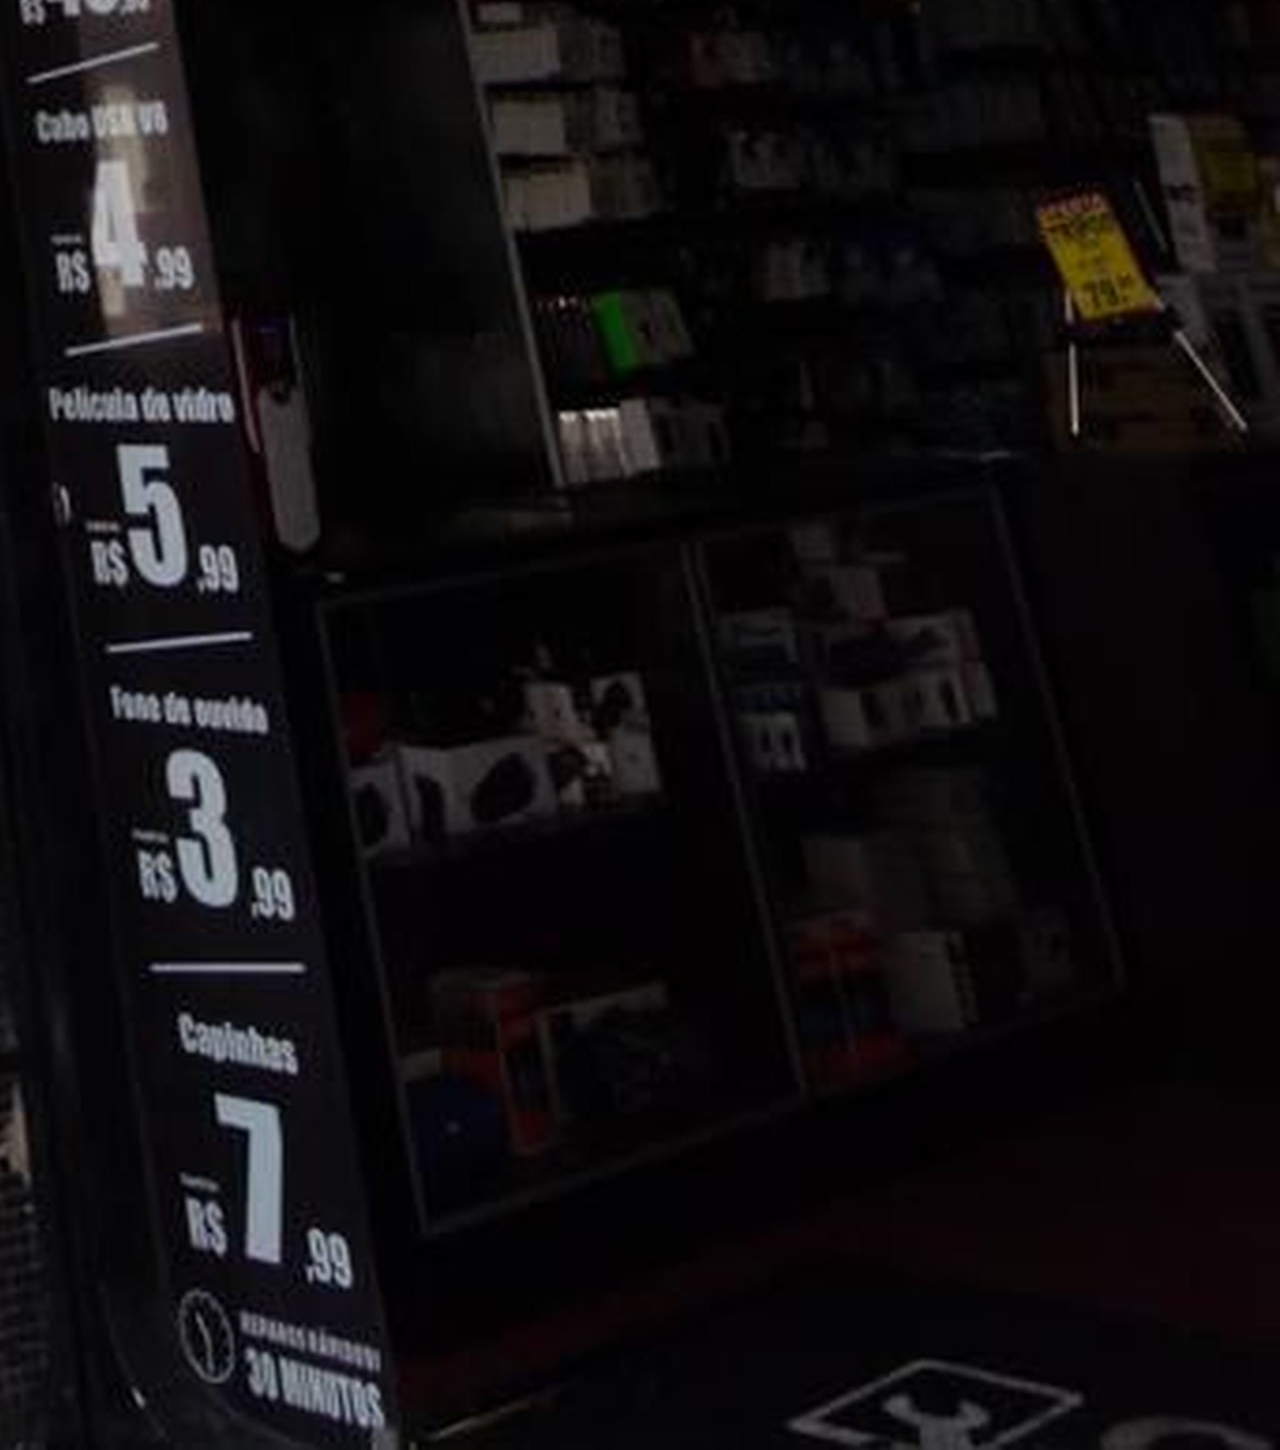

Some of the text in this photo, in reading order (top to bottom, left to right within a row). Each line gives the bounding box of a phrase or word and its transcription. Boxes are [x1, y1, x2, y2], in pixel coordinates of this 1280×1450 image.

[36, 109, 90, 143] Cabo
[173, 387, 236, 423] vidro
[178, 1012, 300, 1076] Capinhas
